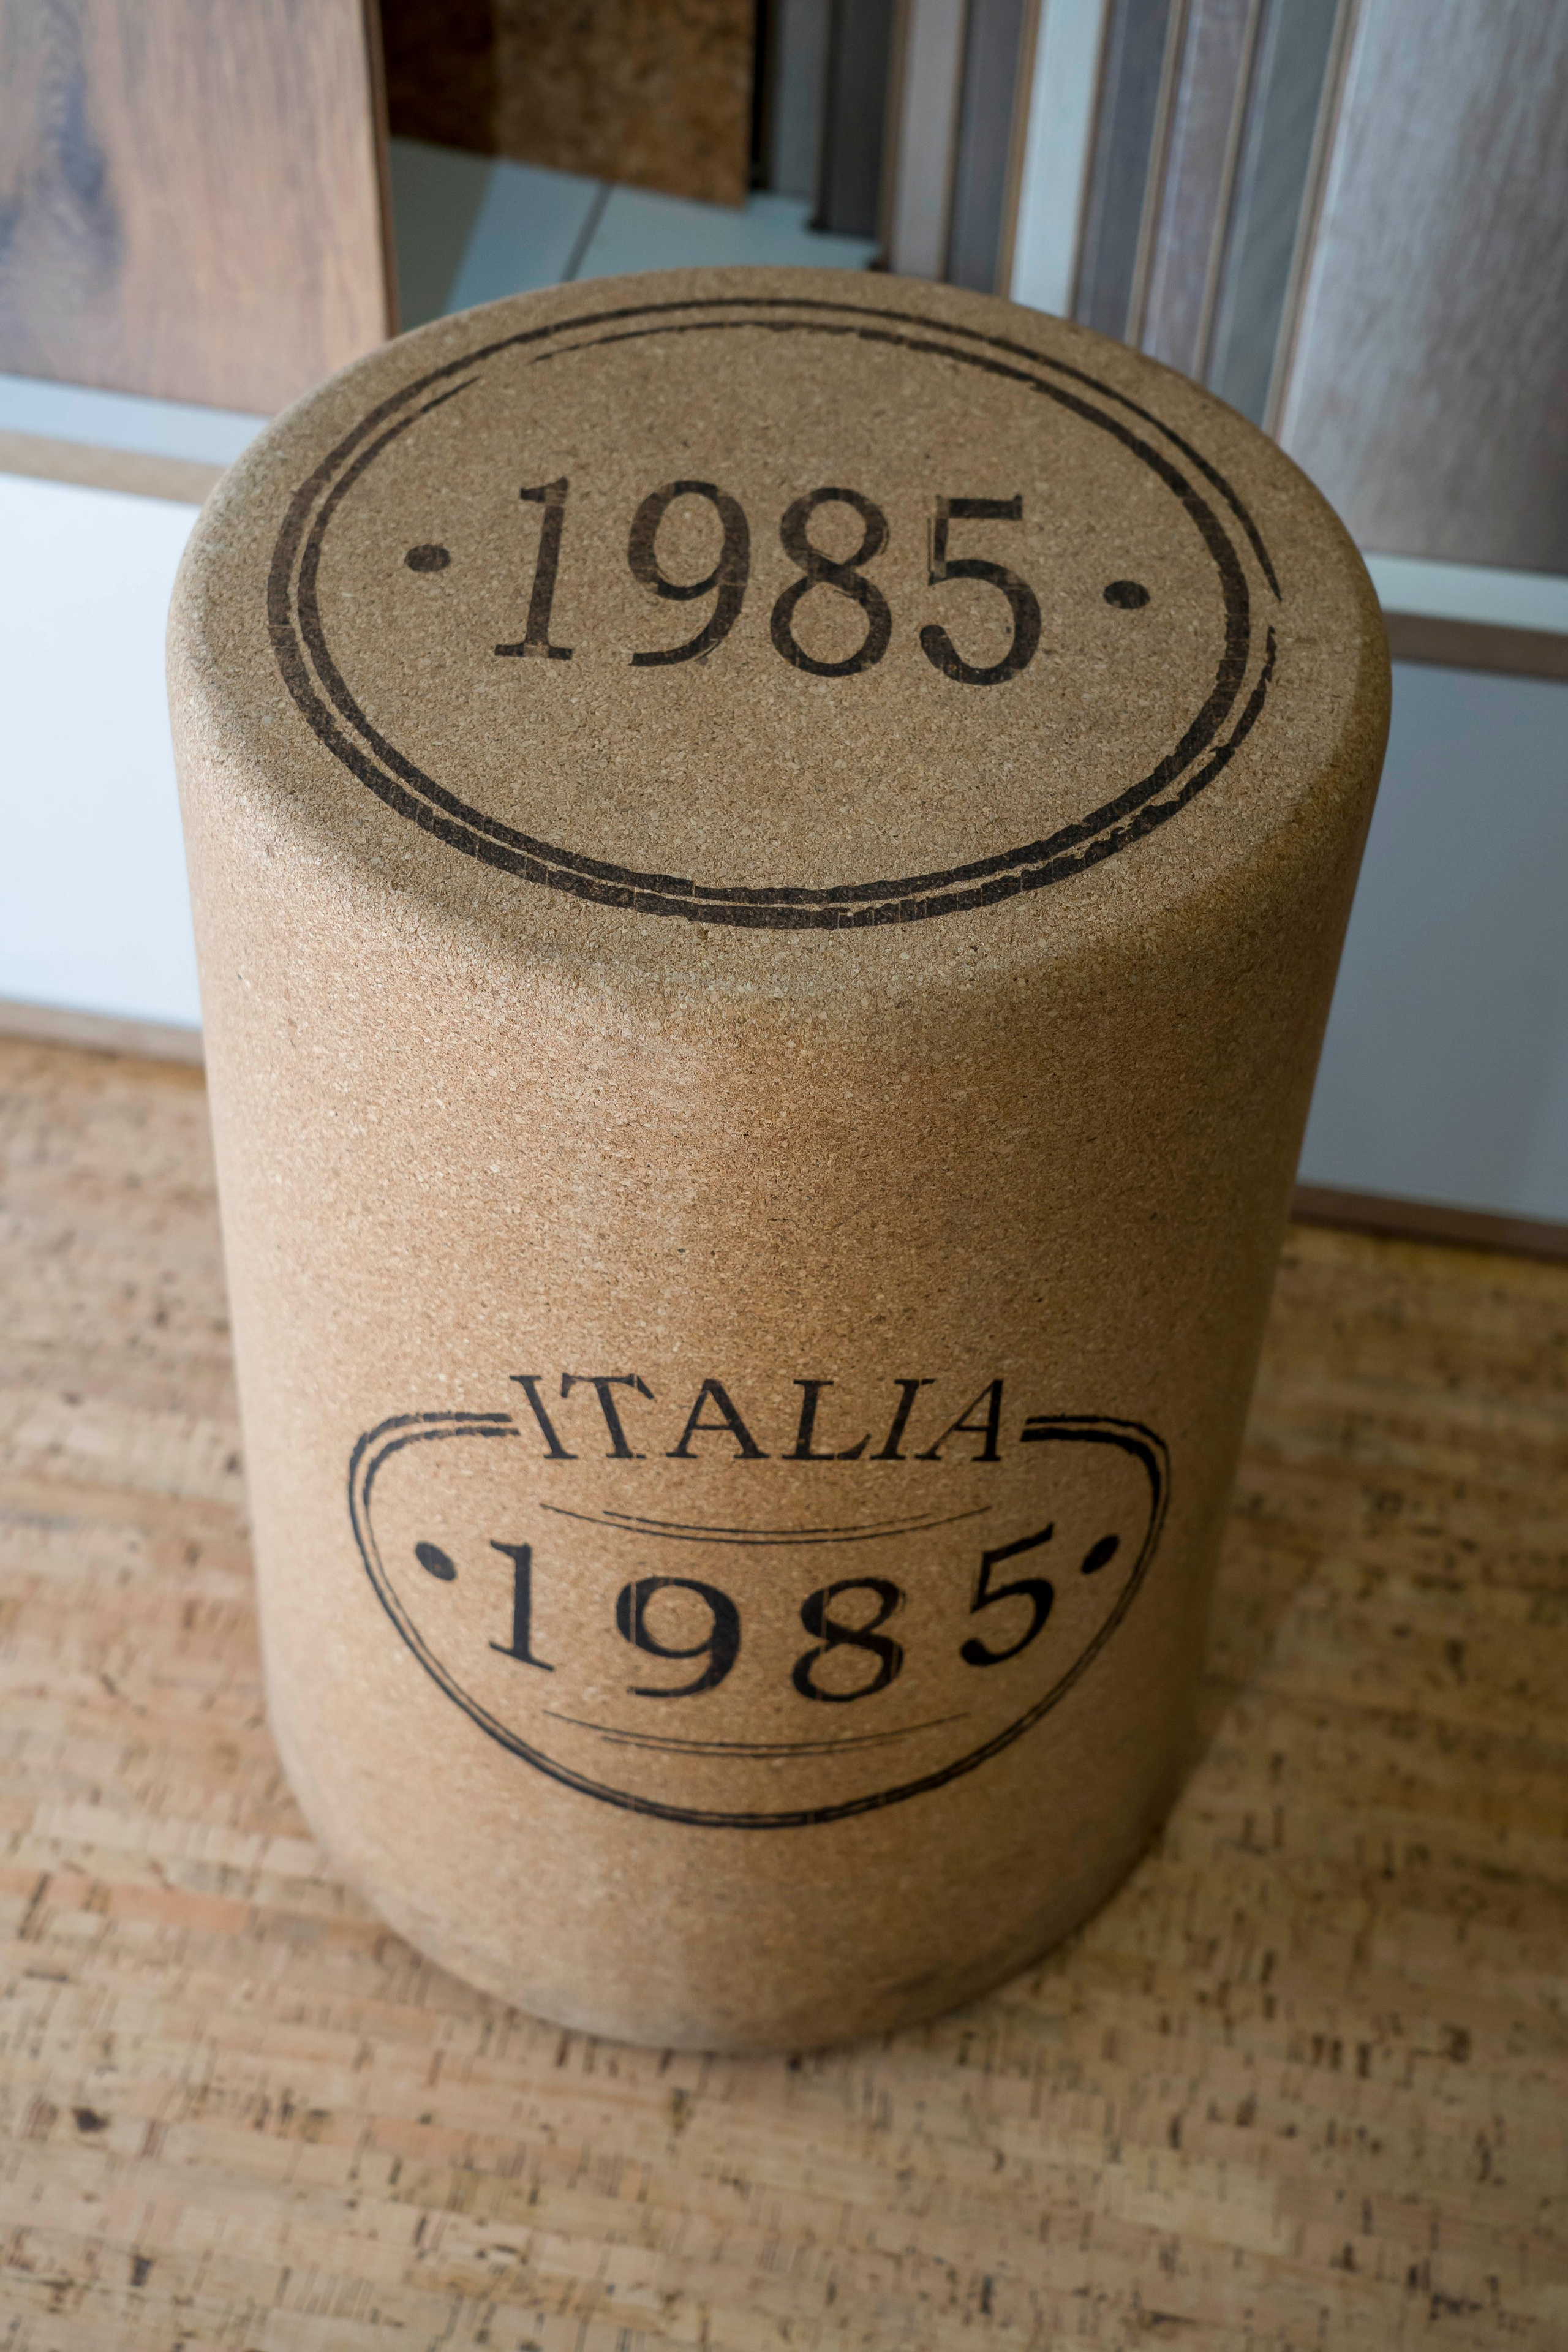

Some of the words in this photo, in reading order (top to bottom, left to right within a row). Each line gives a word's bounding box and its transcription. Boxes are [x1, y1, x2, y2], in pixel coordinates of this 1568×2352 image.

[494, 477, 1041, 687] 1985
[508, 1372, 1004, 1463] ITALIA
[489, 1523, 1055, 1703] 1985
